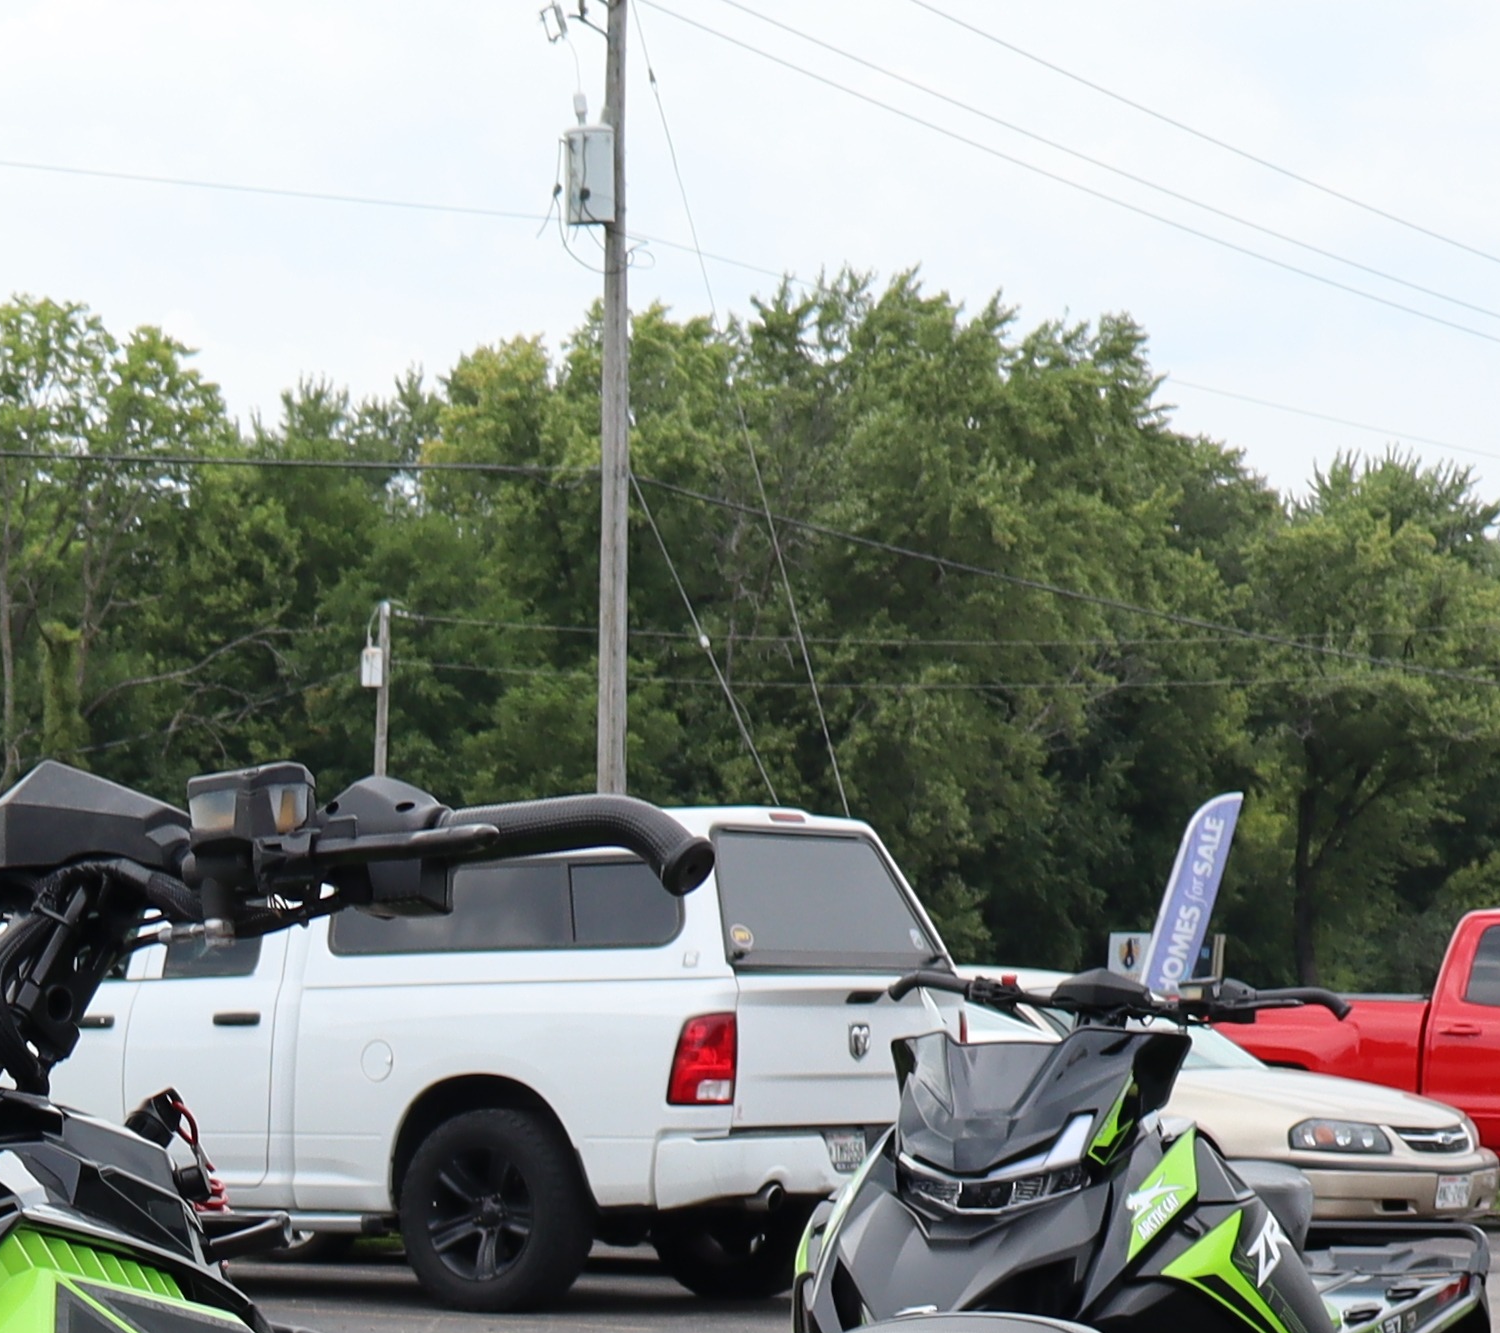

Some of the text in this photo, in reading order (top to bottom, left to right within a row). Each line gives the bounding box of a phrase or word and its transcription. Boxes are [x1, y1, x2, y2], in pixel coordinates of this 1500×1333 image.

[1193, 815, 1225, 878] SALE
[1136, 1192, 1181, 1241] ARCTIC CAT
[1246, 1210, 1293, 1289] ZR
